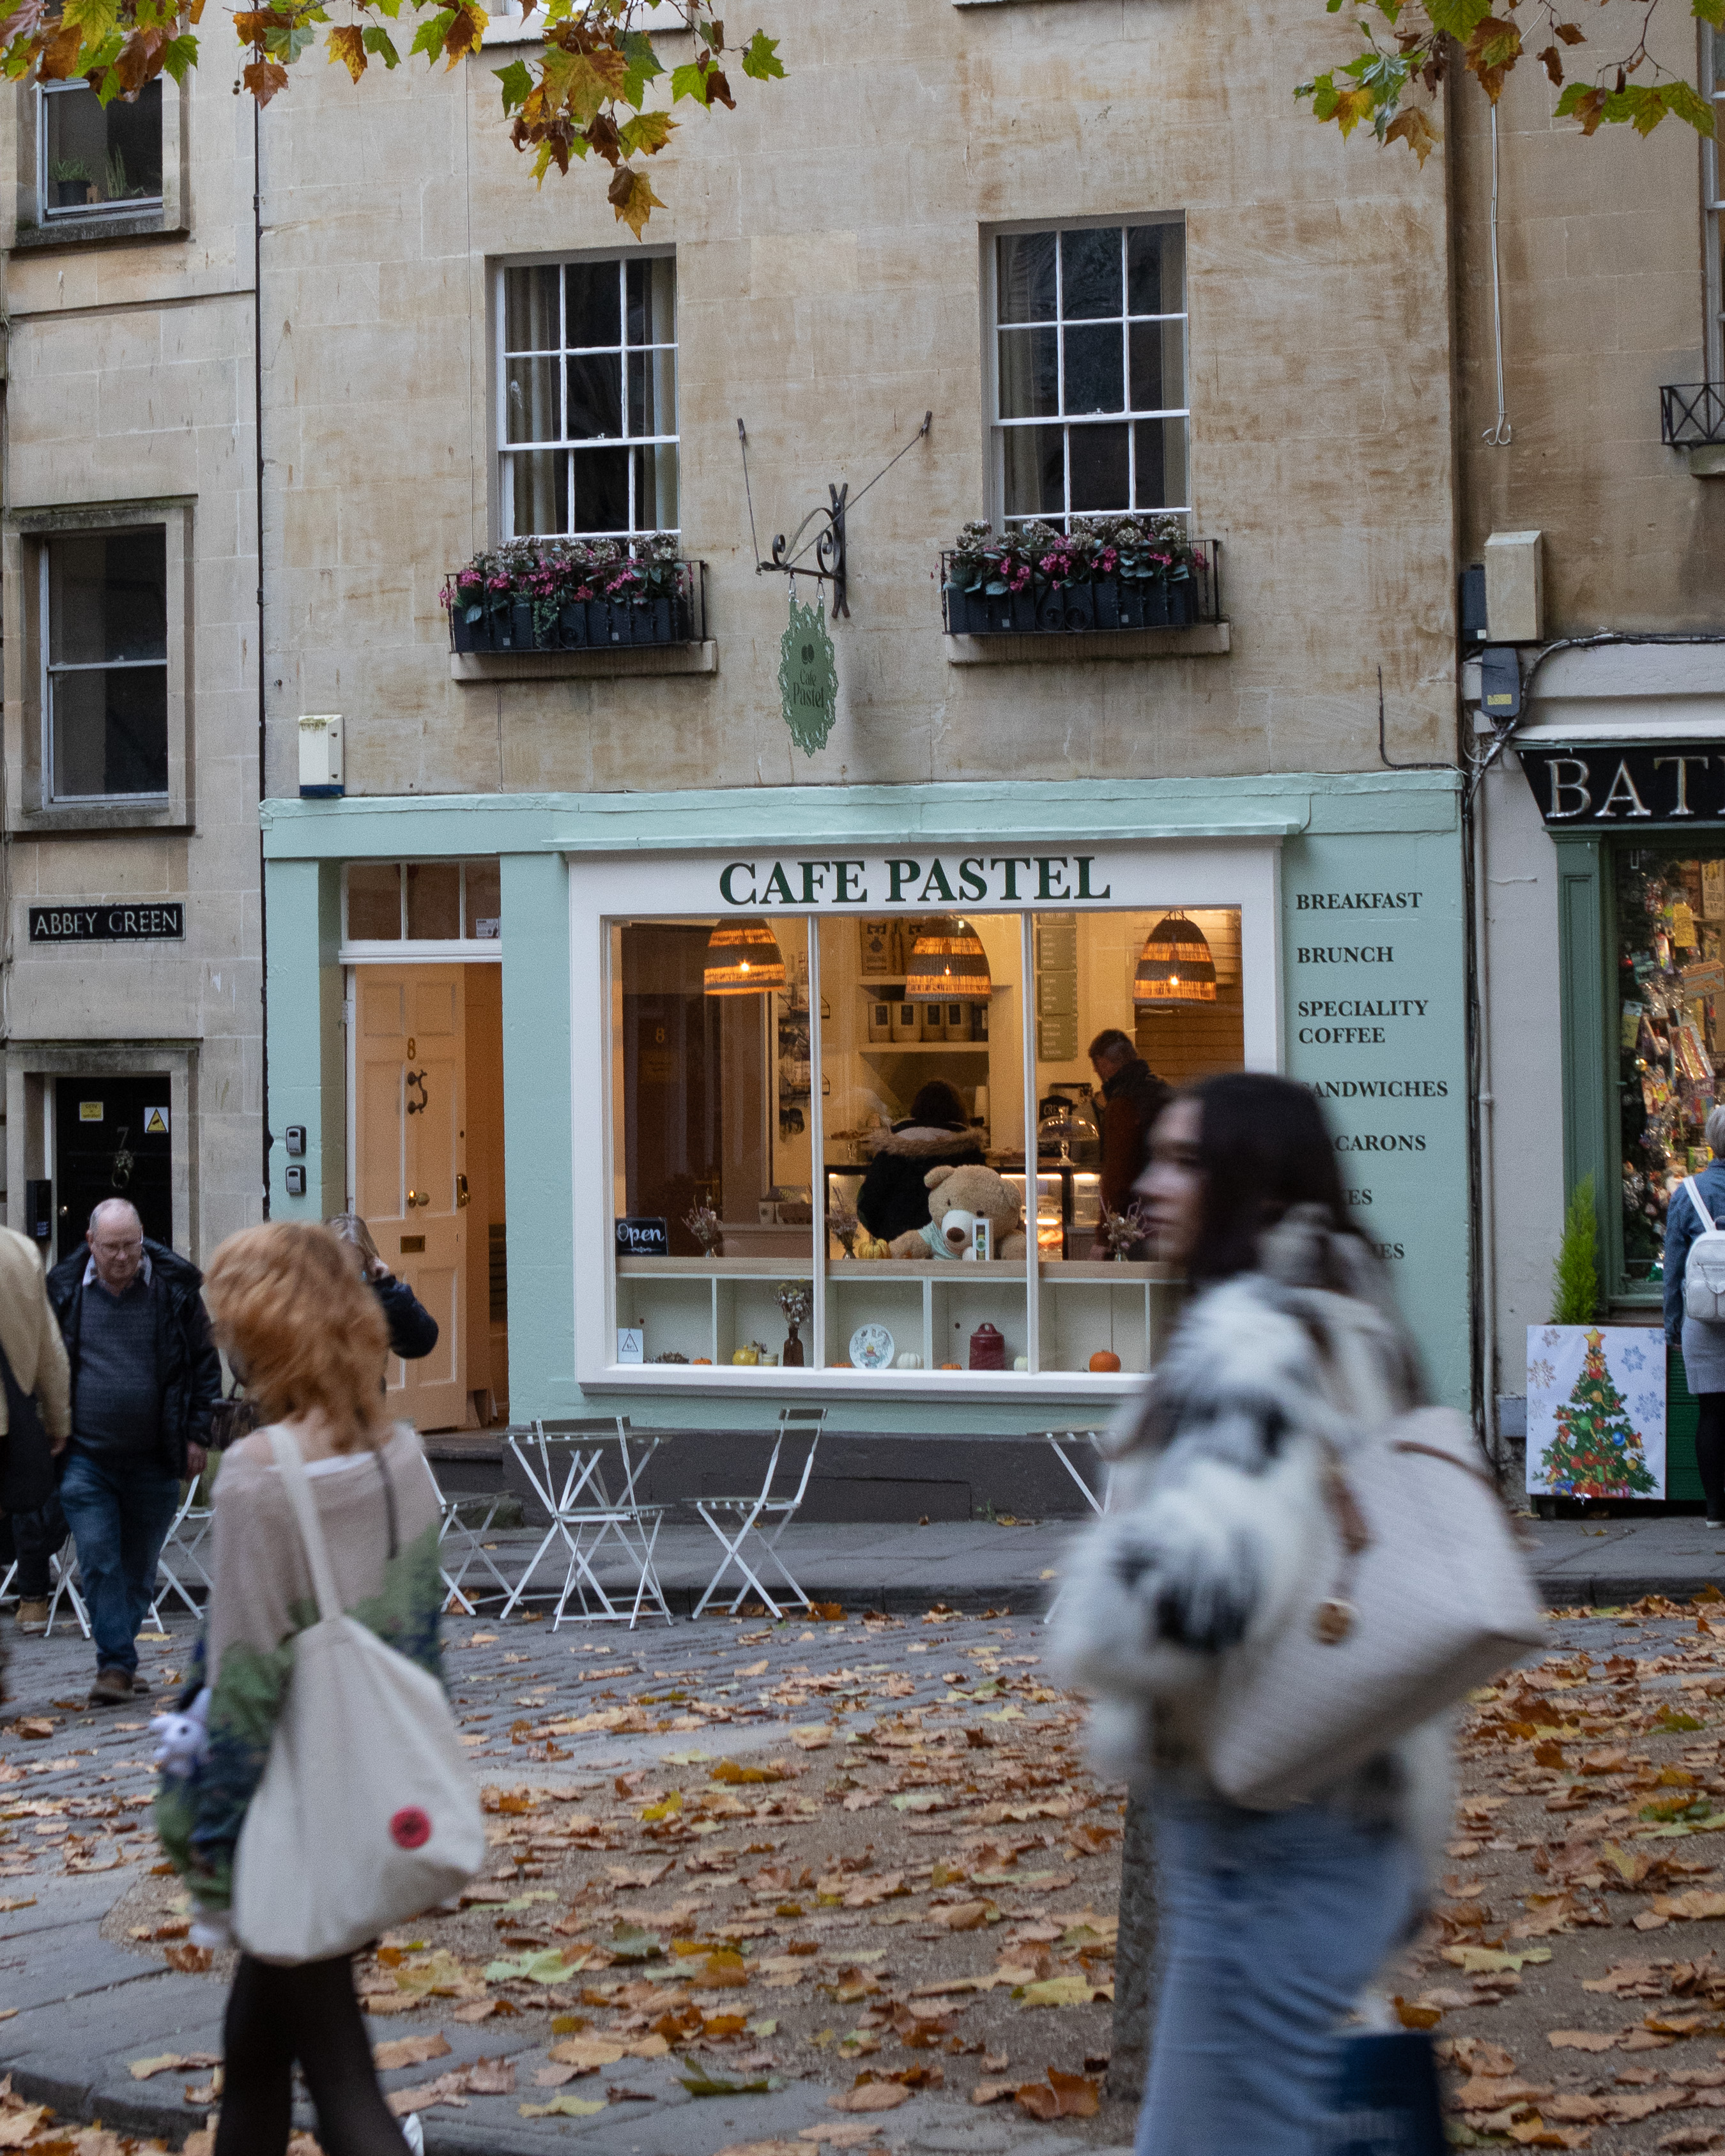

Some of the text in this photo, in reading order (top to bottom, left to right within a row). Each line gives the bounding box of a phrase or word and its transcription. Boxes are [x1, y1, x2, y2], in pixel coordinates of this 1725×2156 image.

[793, 682, 824, 708] Pastel
[1544, 756, 1725, 818] BAT
[719, 856, 1111, 906] CAFE PASTEL
[1296, 892, 1423, 910] BREAKFAST
[34, 910, 178, 936] ABBEY GREEN
[1297, 947, 1394, 963] BRUNCH
[1298, 1000, 1429, 1017] SPECIALITY
[656, 1027, 664, 1043] 8
[1299, 1027, 1386, 1044] COFFEE
[407, 1037, 416, 1060] 8
[1305, 1080, 1449, 1098] ANDWICHES
[117, 1126, 129, 1149] 7
[1334, 1135, 1427, 1151] CARONS
[616, 1222, 665, 1248] Open
